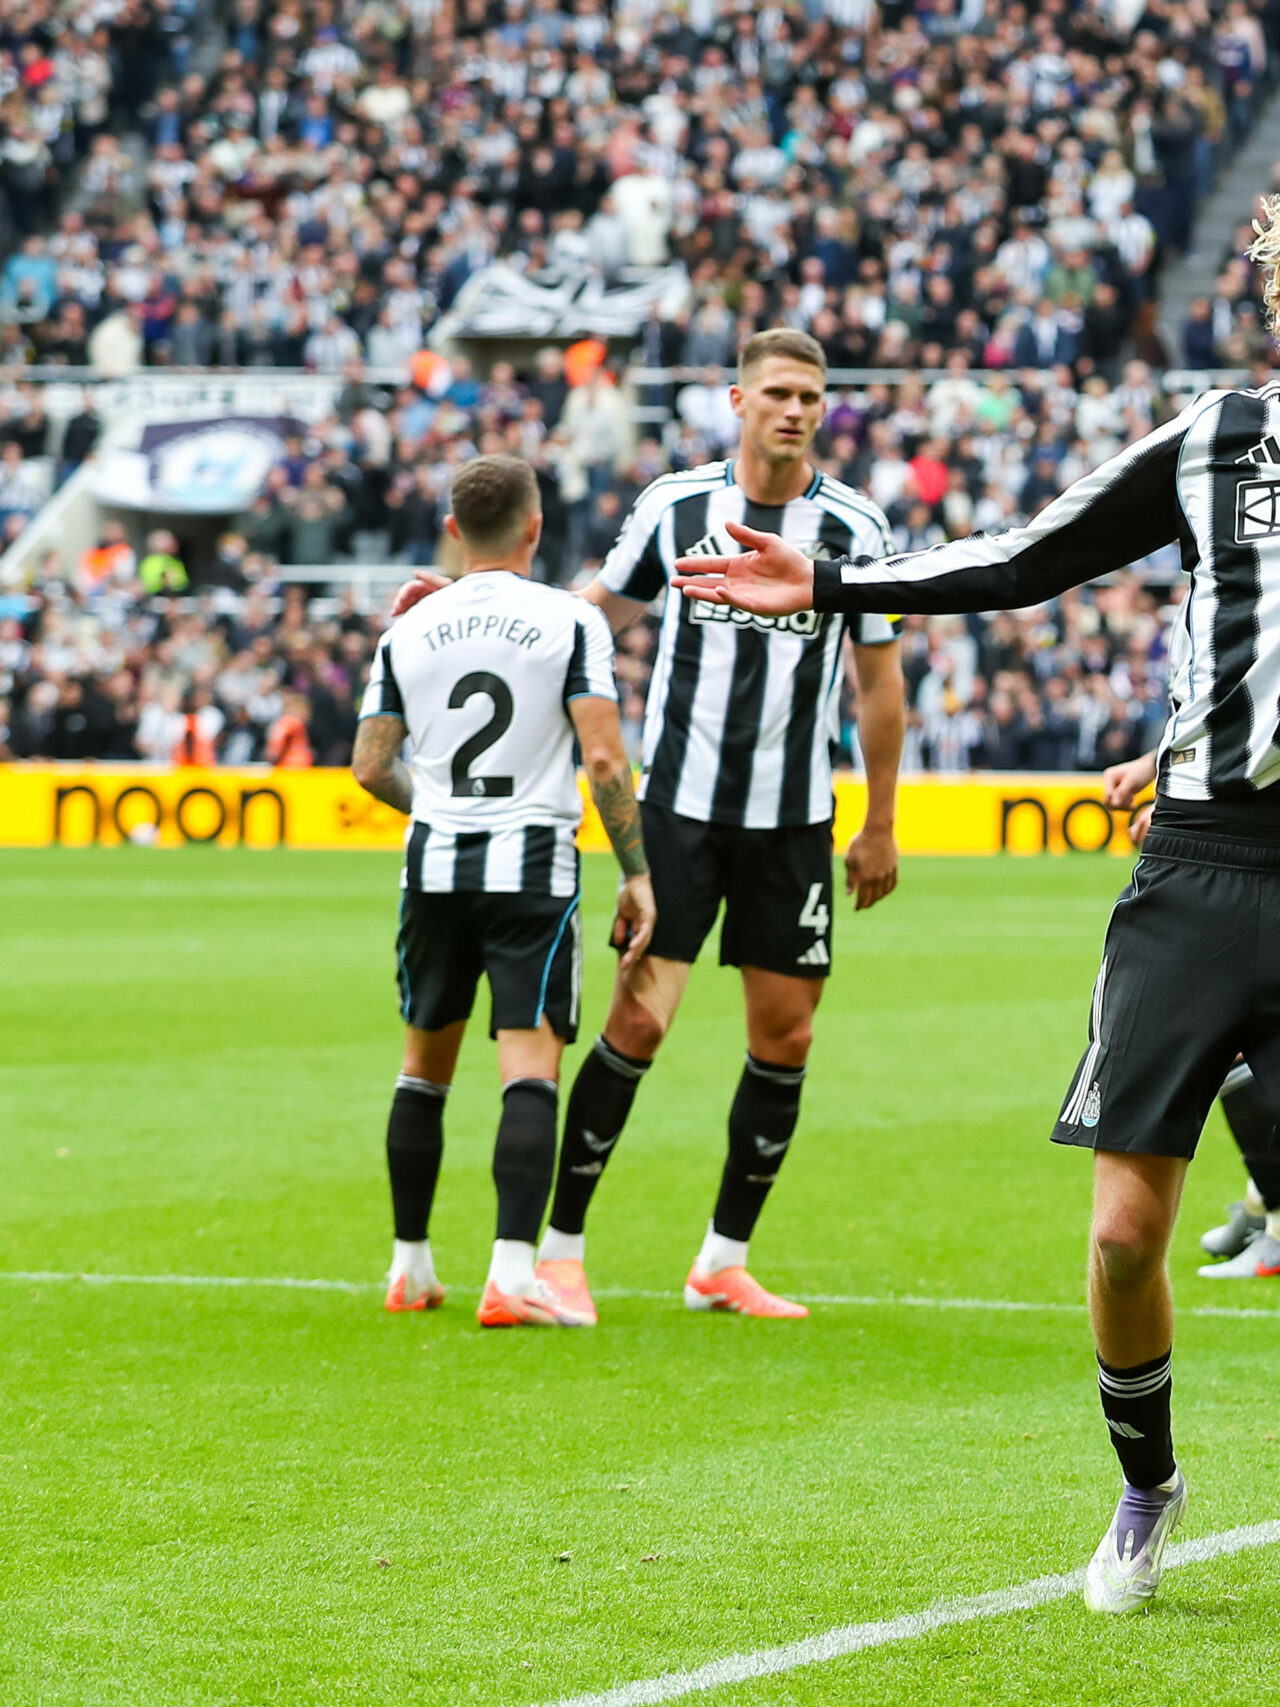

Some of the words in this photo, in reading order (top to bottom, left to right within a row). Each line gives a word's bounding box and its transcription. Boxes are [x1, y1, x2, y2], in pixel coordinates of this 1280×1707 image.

[422, 615, 541, 651] TRIPPIER
[447, 671, 513, 797] 2
[55, 786, 285, 843] noon
[799, 882, 829, 936] 4
